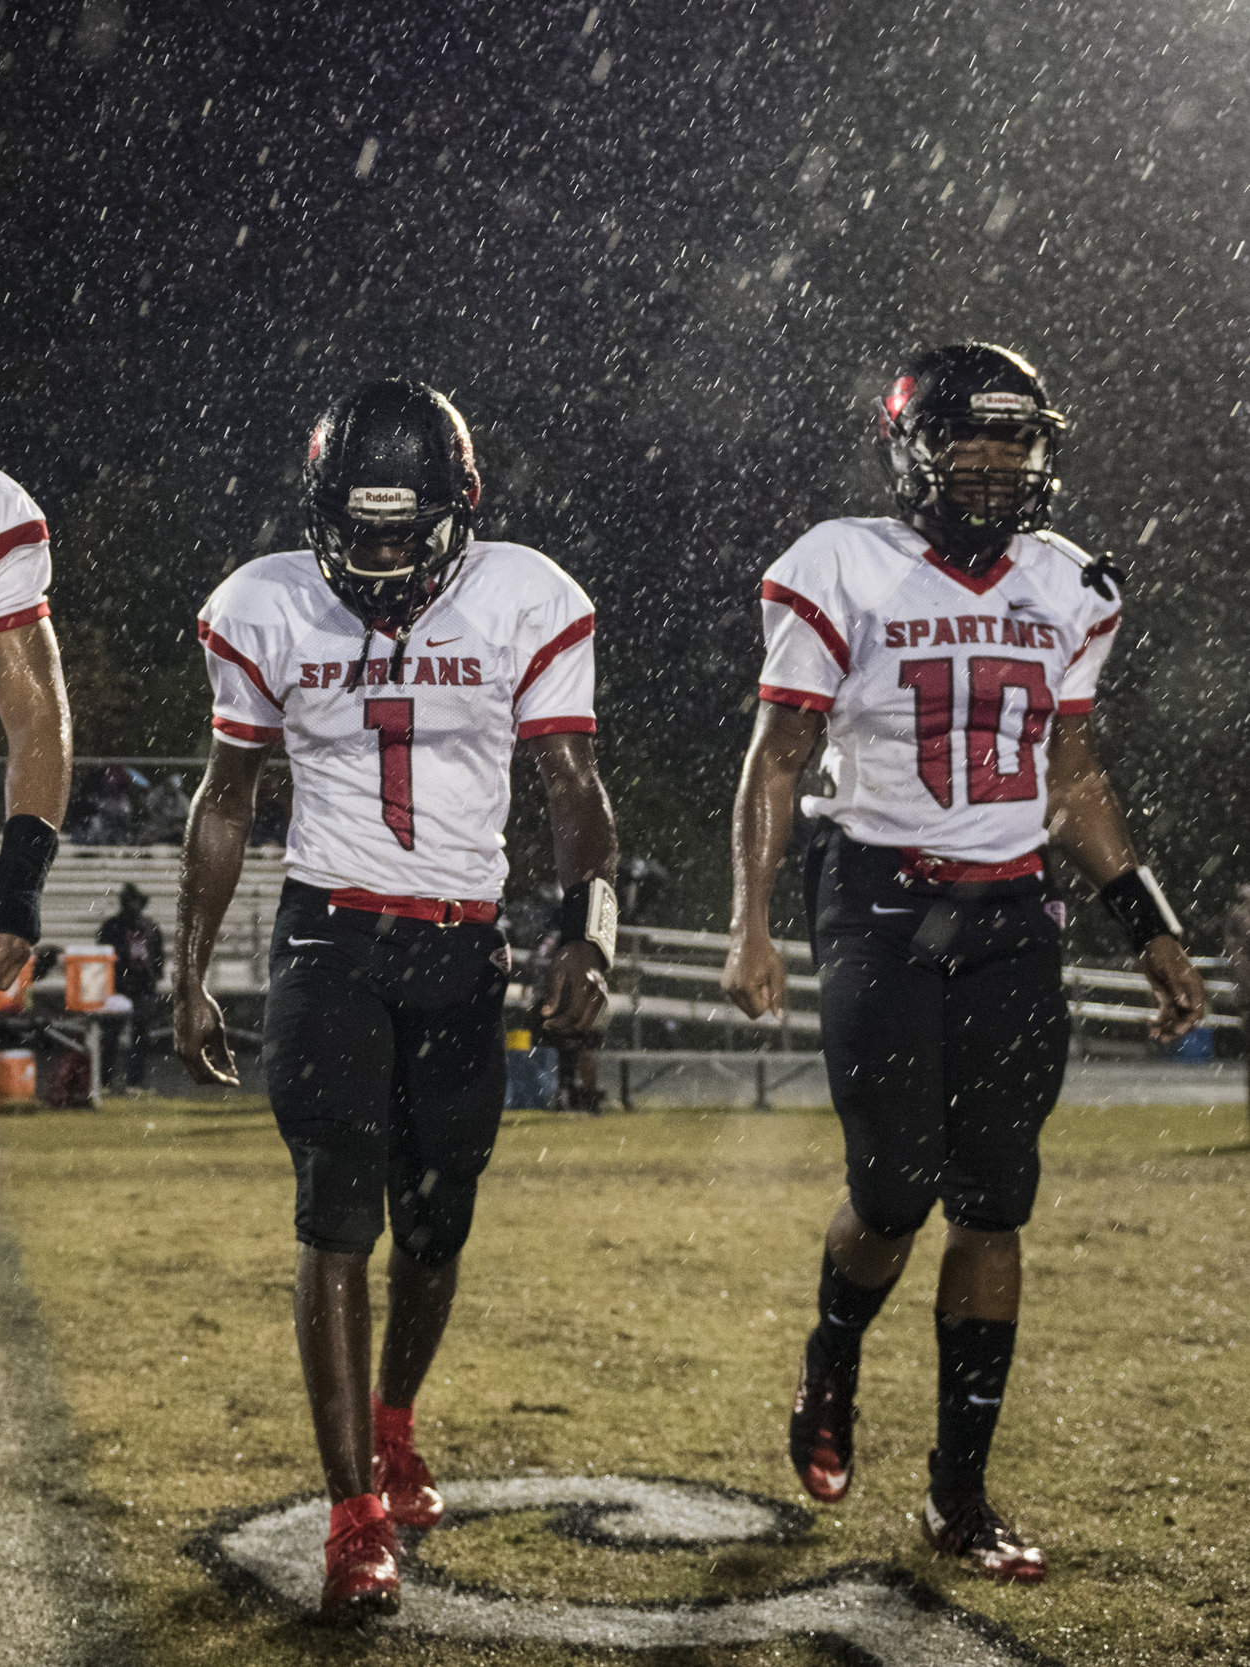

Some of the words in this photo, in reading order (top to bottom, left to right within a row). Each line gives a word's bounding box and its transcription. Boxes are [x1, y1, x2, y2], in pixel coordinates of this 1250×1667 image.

[365, 491, 402, 503] Riddell
[885, 615, 1055, 649] SPARTANS
[364, 697, 416, 851] 1
[898, 655, 1055, 810] 10
